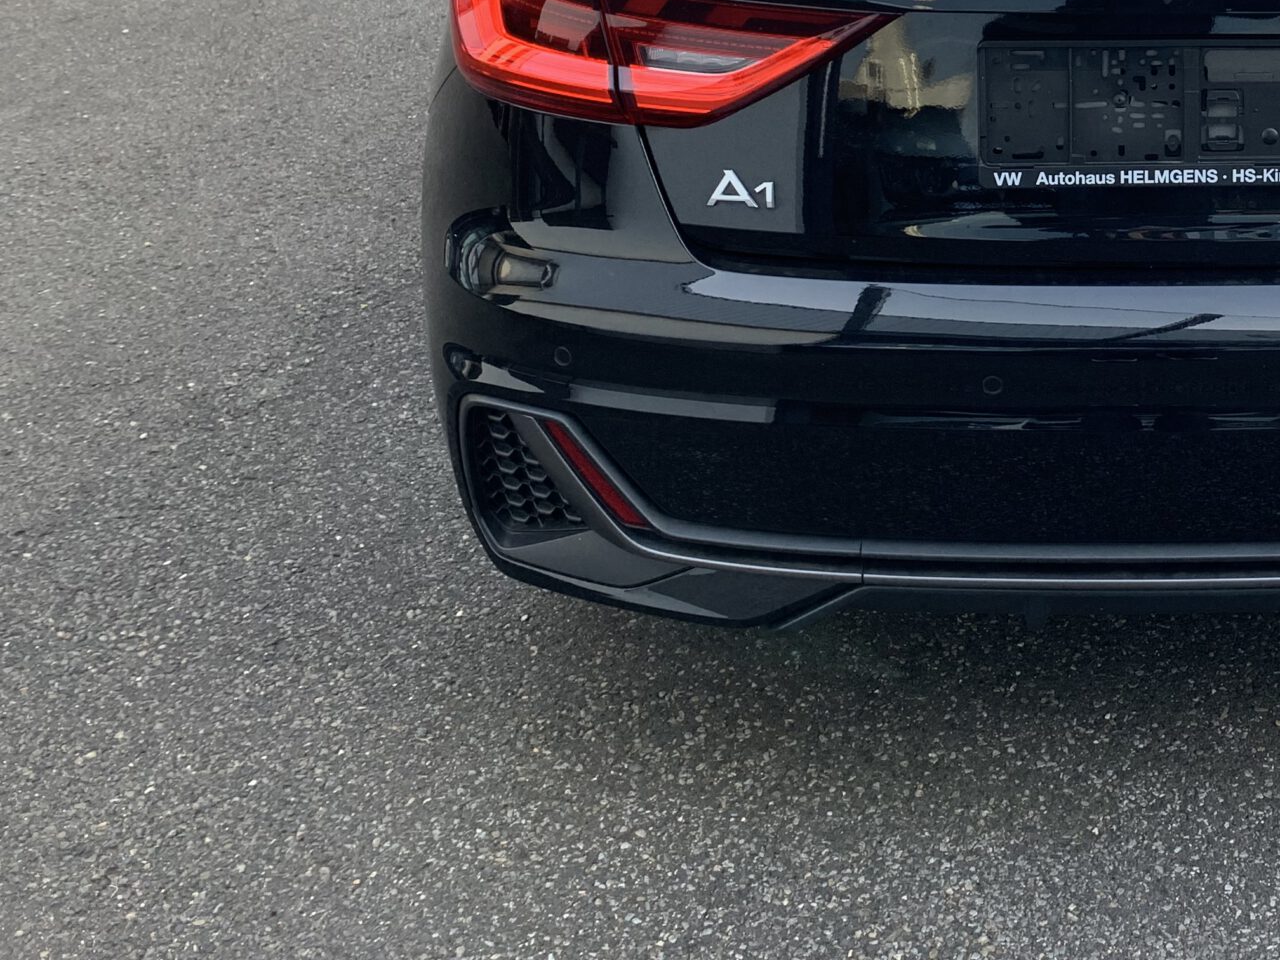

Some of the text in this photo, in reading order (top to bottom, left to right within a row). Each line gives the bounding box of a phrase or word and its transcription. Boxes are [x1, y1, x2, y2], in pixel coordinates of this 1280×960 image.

[706, 169, 775, 209] A1
[993, 172, 1022, 186] VW
[1036, 171, 1116, 185] Autohaus
[1120, 169, 1219, 184] HELMGENS
